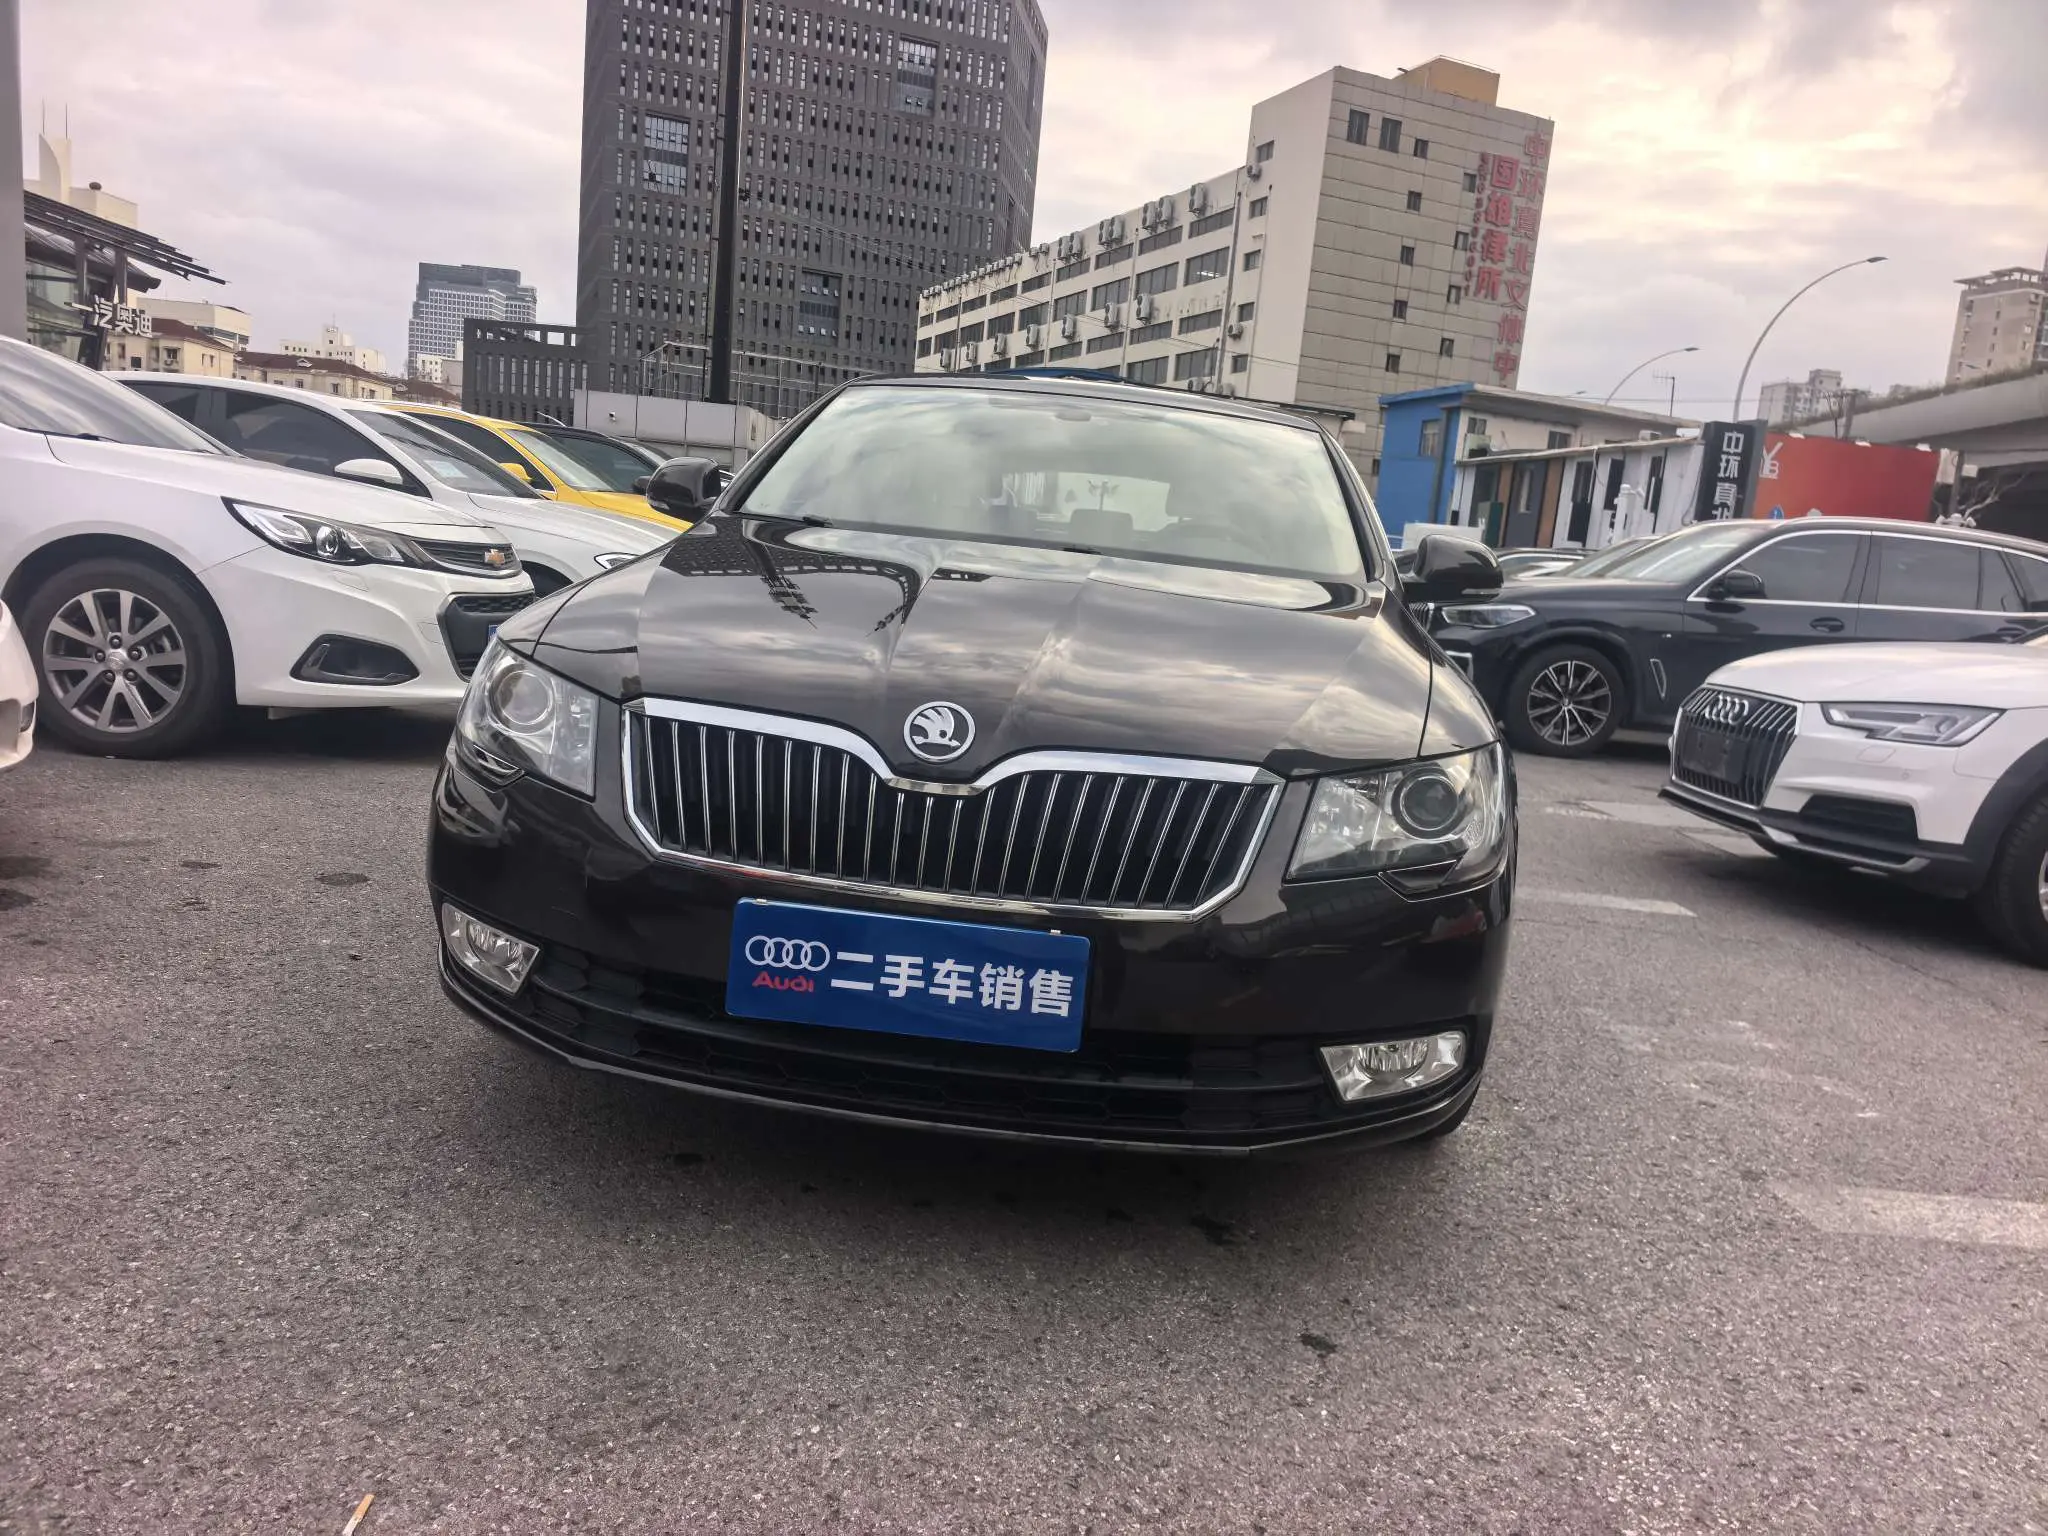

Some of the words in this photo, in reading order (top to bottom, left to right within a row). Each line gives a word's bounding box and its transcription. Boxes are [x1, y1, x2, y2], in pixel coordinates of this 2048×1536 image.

[1493, 131, 1549, 387] 中环真北文体中
[64, 294, 153, 338] 一汽奥迪
[752, 971, 815, 993] Audi
[831, 951, 1074, 1017] 二手车销售
